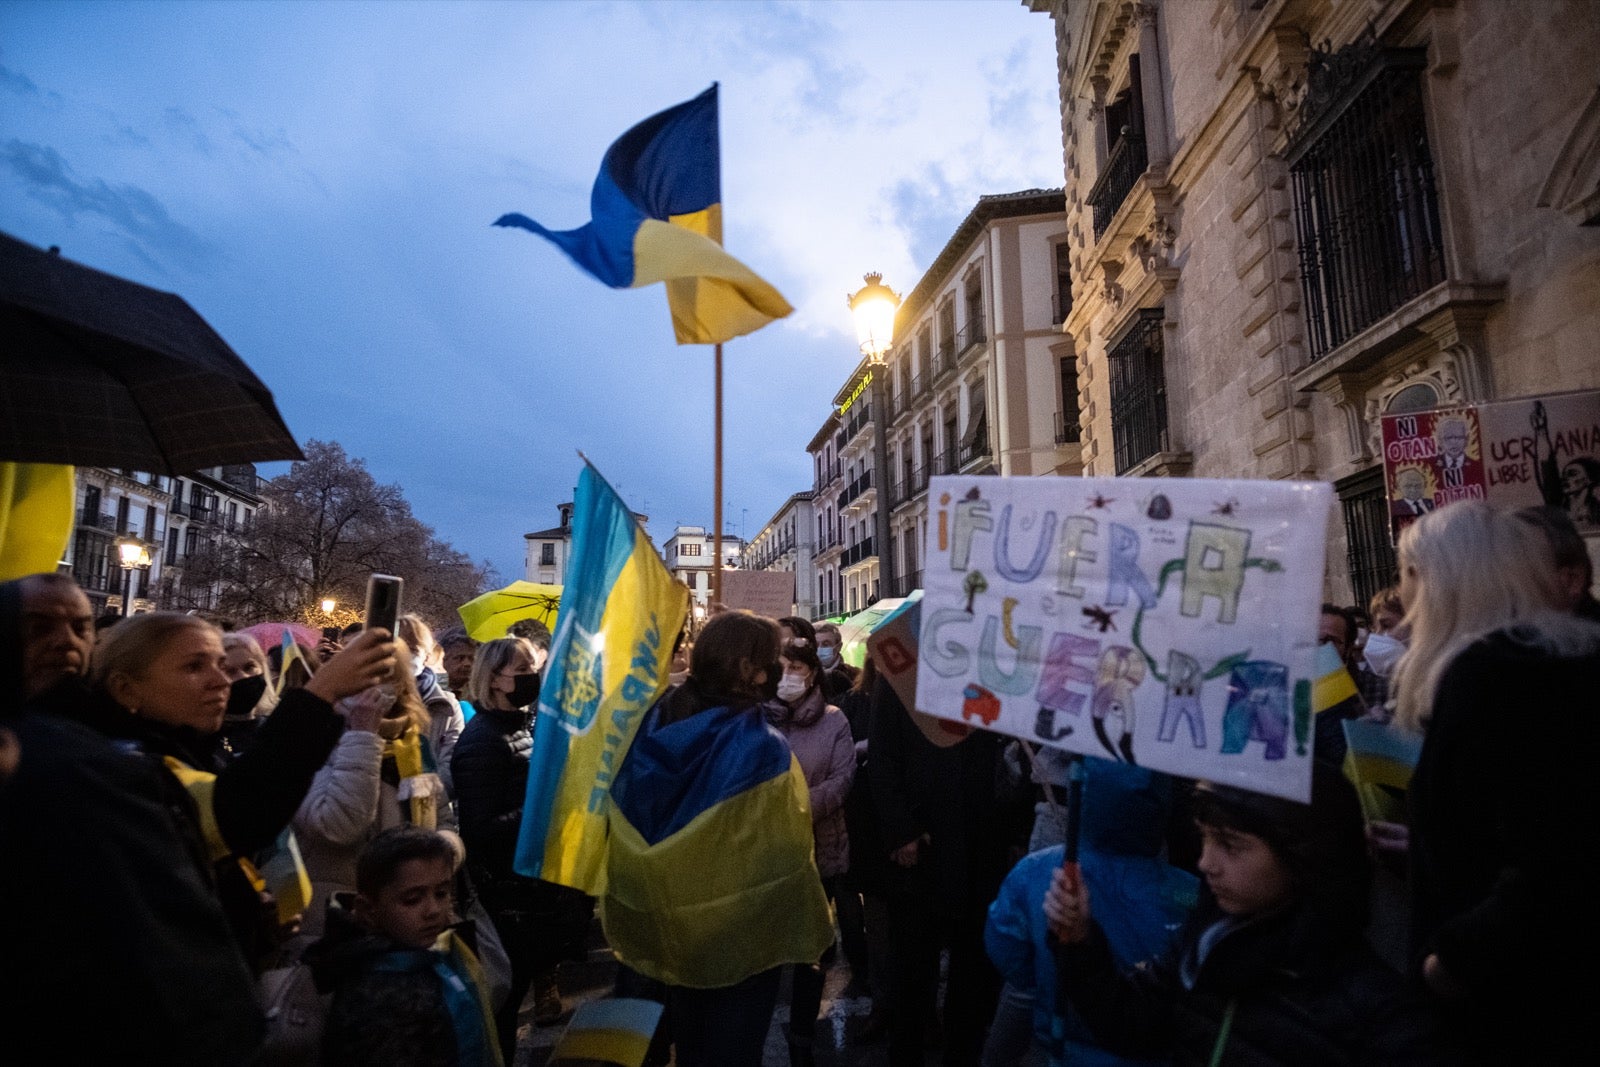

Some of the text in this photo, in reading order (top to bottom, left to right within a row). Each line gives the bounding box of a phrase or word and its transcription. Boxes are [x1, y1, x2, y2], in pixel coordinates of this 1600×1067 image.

[1395, 417, 1417, 438] NI
[1387, 437, 1438, 462] OTAN
[1442, 467, 1464, 489] NI
[1488, 462, 1531, 487] LIBRE
[1433, 484, 1484, 508] PUTIN
